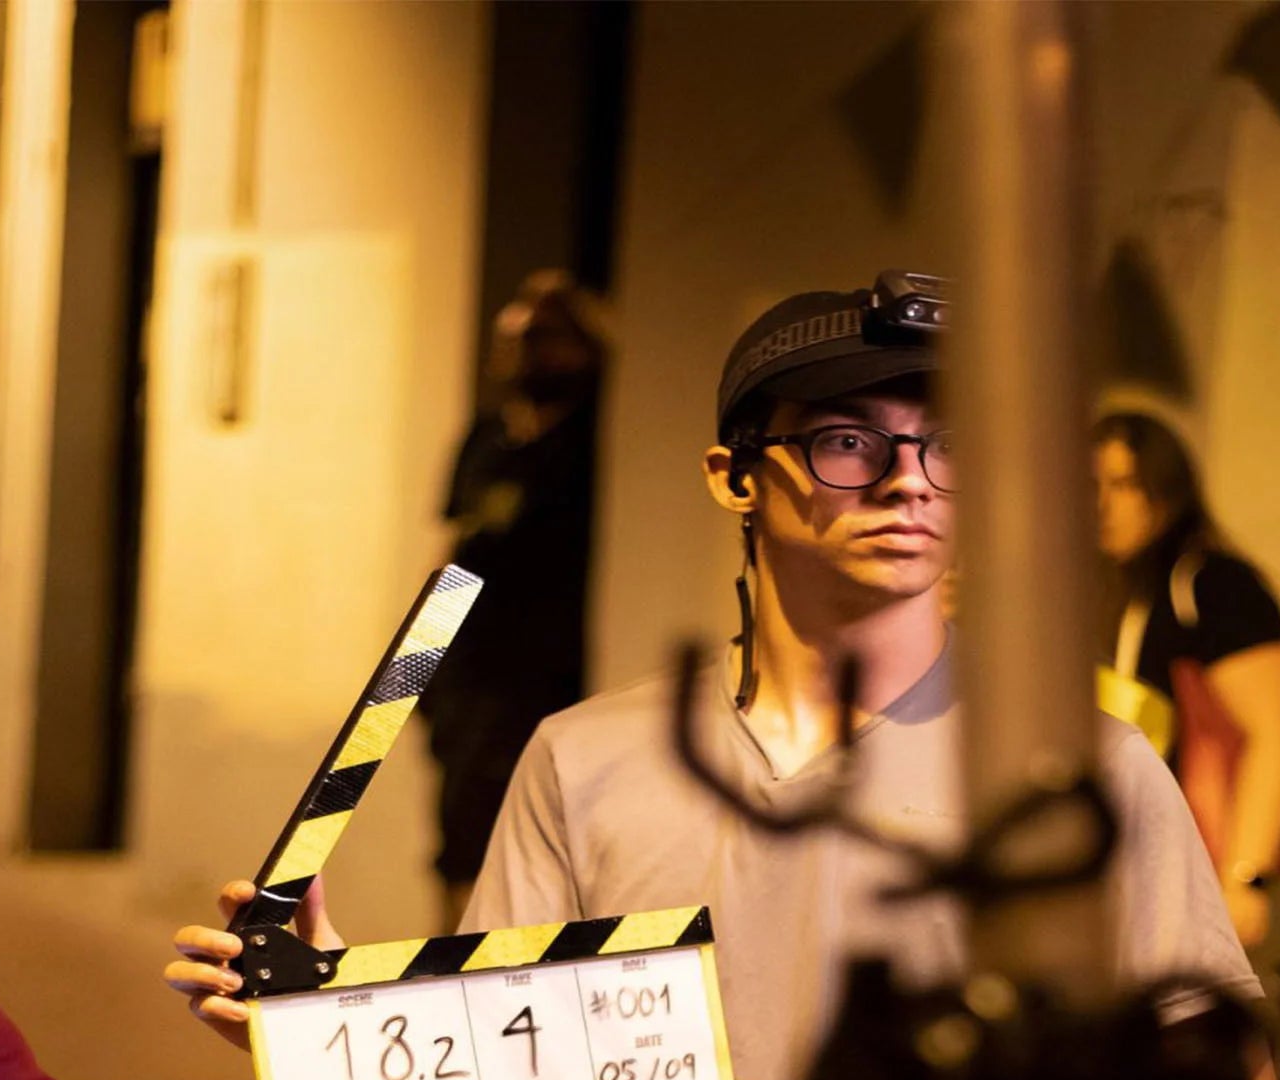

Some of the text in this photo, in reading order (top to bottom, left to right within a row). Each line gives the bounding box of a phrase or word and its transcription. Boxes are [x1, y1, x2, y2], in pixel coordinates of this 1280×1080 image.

[504, 972, 533, 987] TAKE
[338, 993, 373, 1008] SCENE
[590, 984, 671, 1019] #001
[501, 1005, 542, 1077] 4
[635, 1034, 662, 1048] DATE
